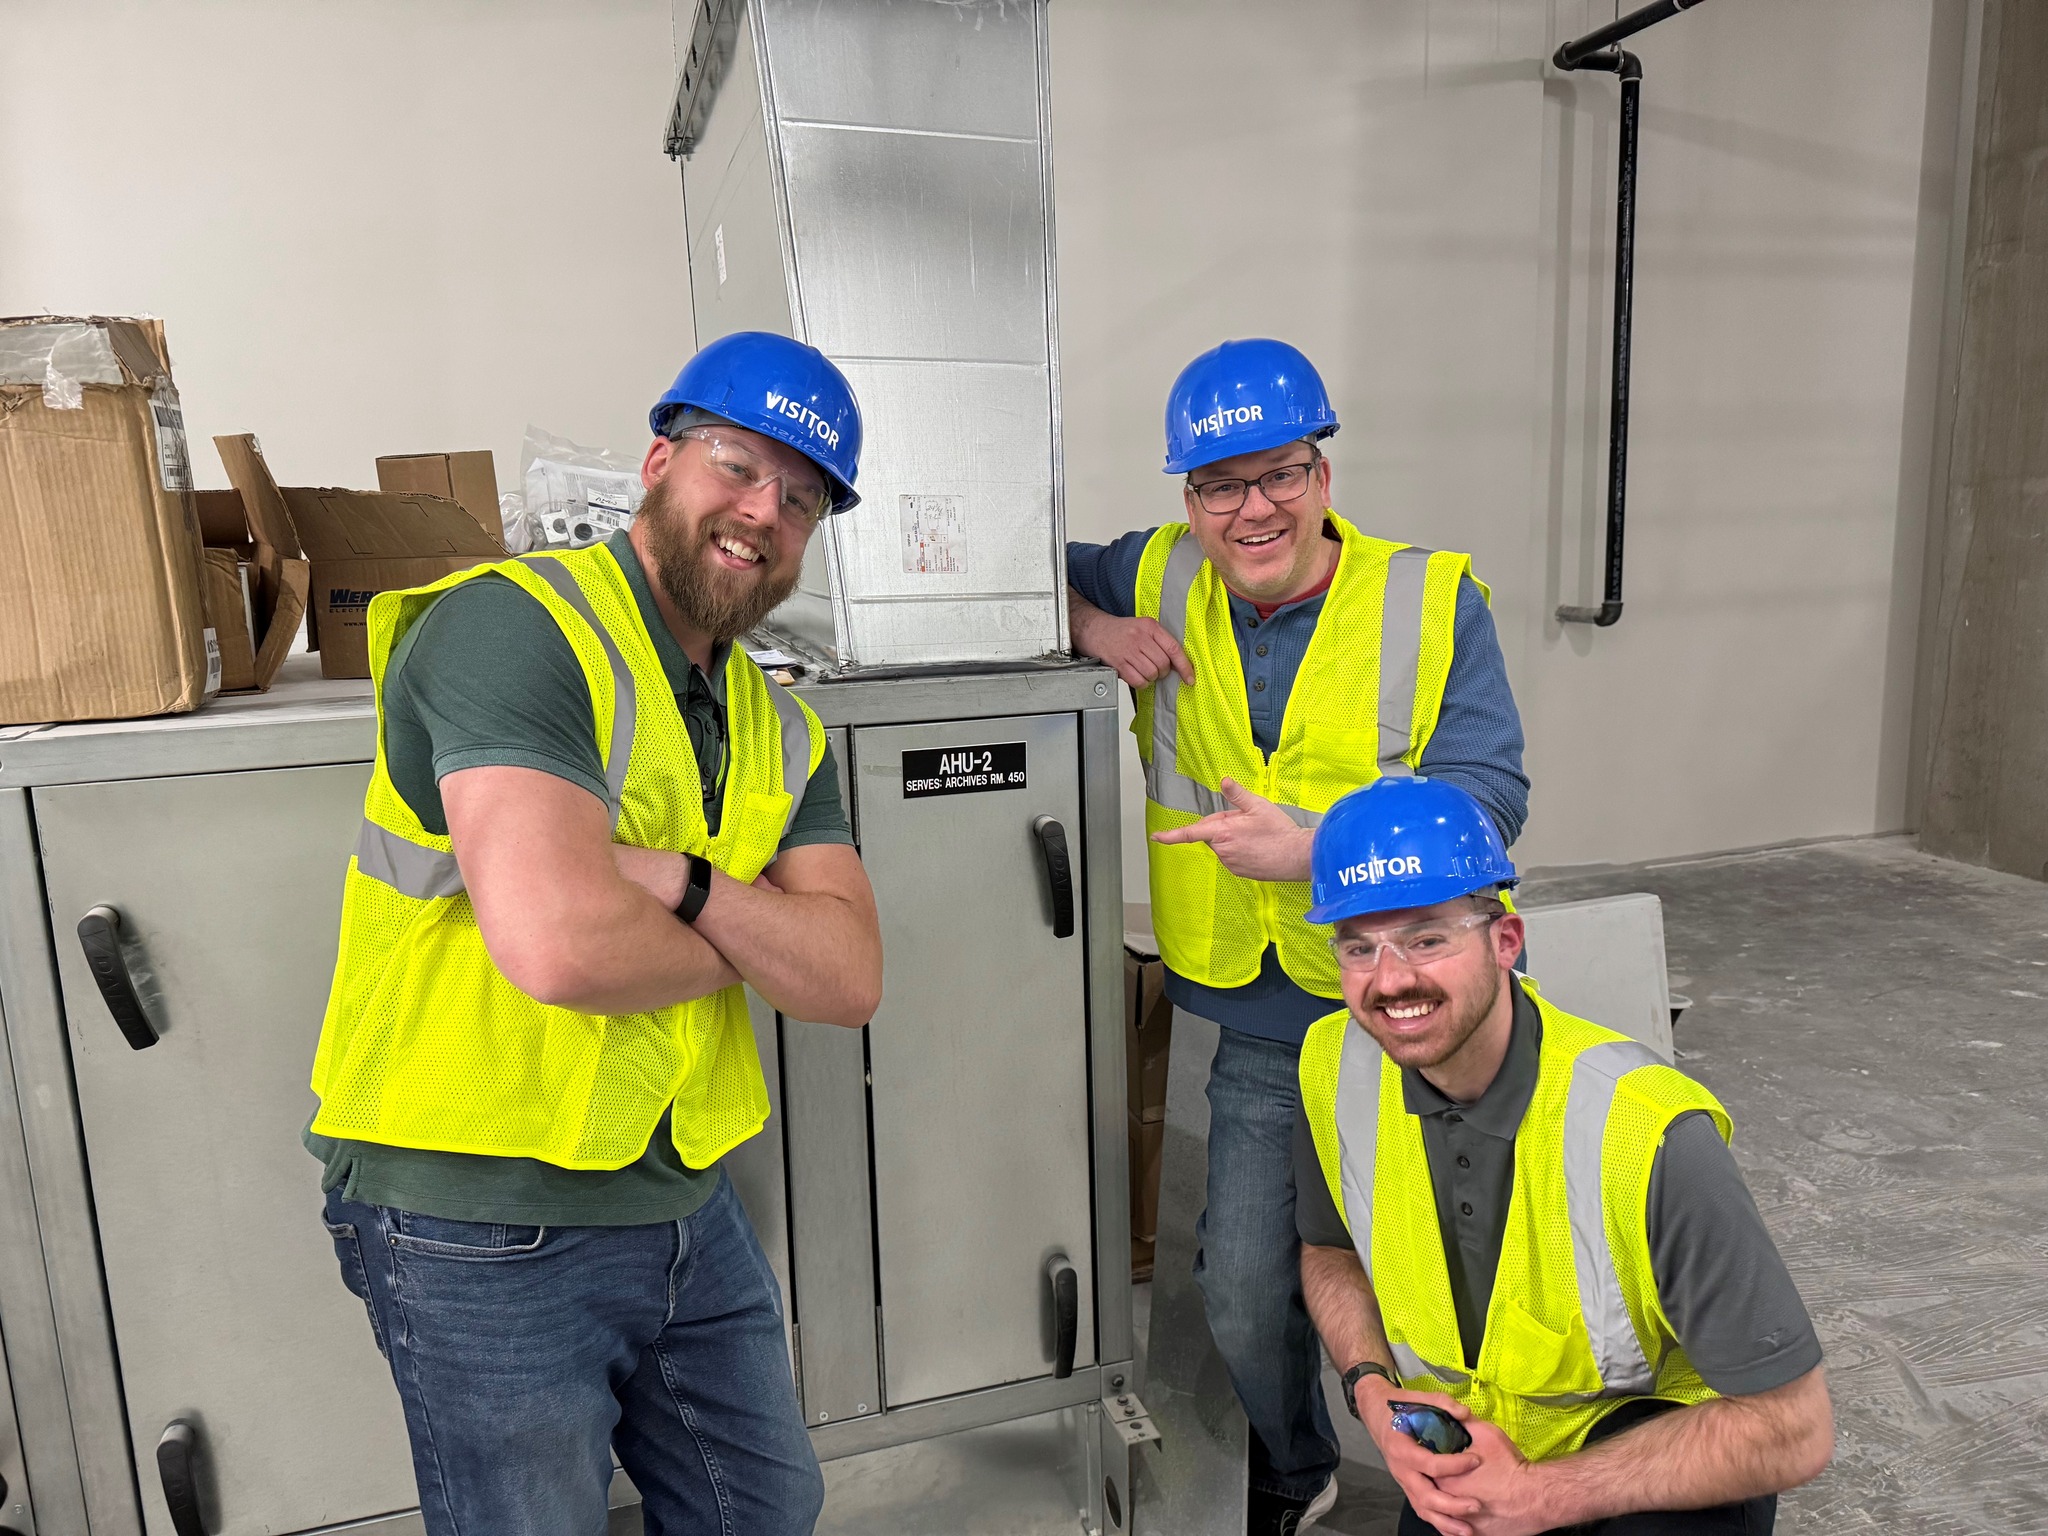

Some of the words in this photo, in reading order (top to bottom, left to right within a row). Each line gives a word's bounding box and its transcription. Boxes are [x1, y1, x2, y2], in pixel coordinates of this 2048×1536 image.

[766, 391, 840, 451] VISITOR
[1192, 405, 1264, 437] VISITOR
[330, 589, 381, 603] WER
[939, 751, 993, 775] AHU-2
[906, 778, 943, 792] SERVES:
[945, 774, 988, 788] ARCHIVES
[990, 772, 1005, 785] RM.
[1008, 771, 1025, 783] 450
[1338, 856, 1422, 887] VISITOR
